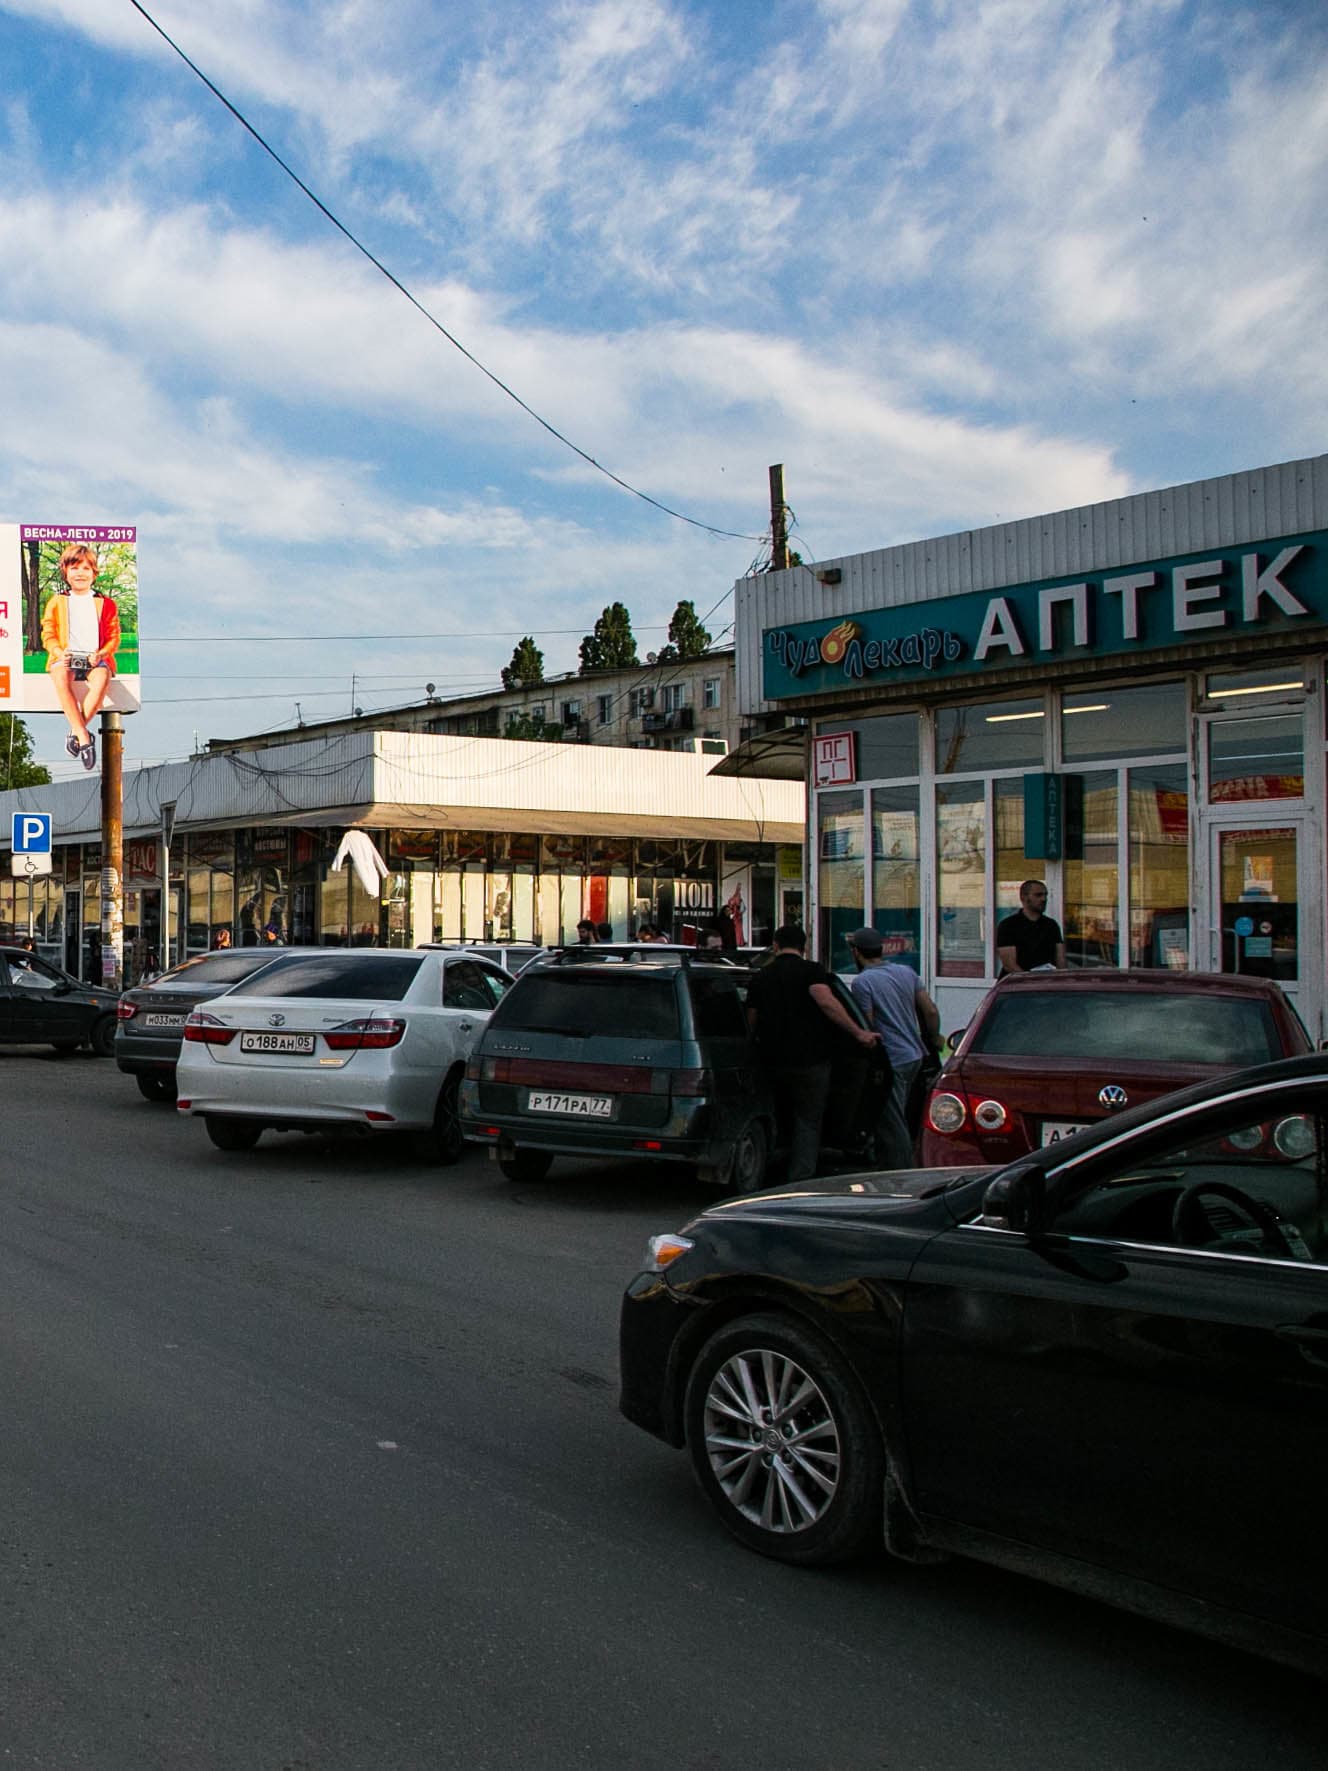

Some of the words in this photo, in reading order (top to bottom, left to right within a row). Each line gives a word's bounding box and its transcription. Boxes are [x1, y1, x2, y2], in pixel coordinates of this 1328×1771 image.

[24, 528, 97, 539] ВЕСНА-ЛЕТО
[107, 529, 133, 539] 2019
[823, 740, 842, 760] ПГ
[1048, 777, 1057, 856] АПТЕКА
[23, 818, 44, 848] P
[296, 1036, 310, 1048] 05
[533, 1095, 588, 1113] Р171РА
[593, 1098, 607, 1111] 77
